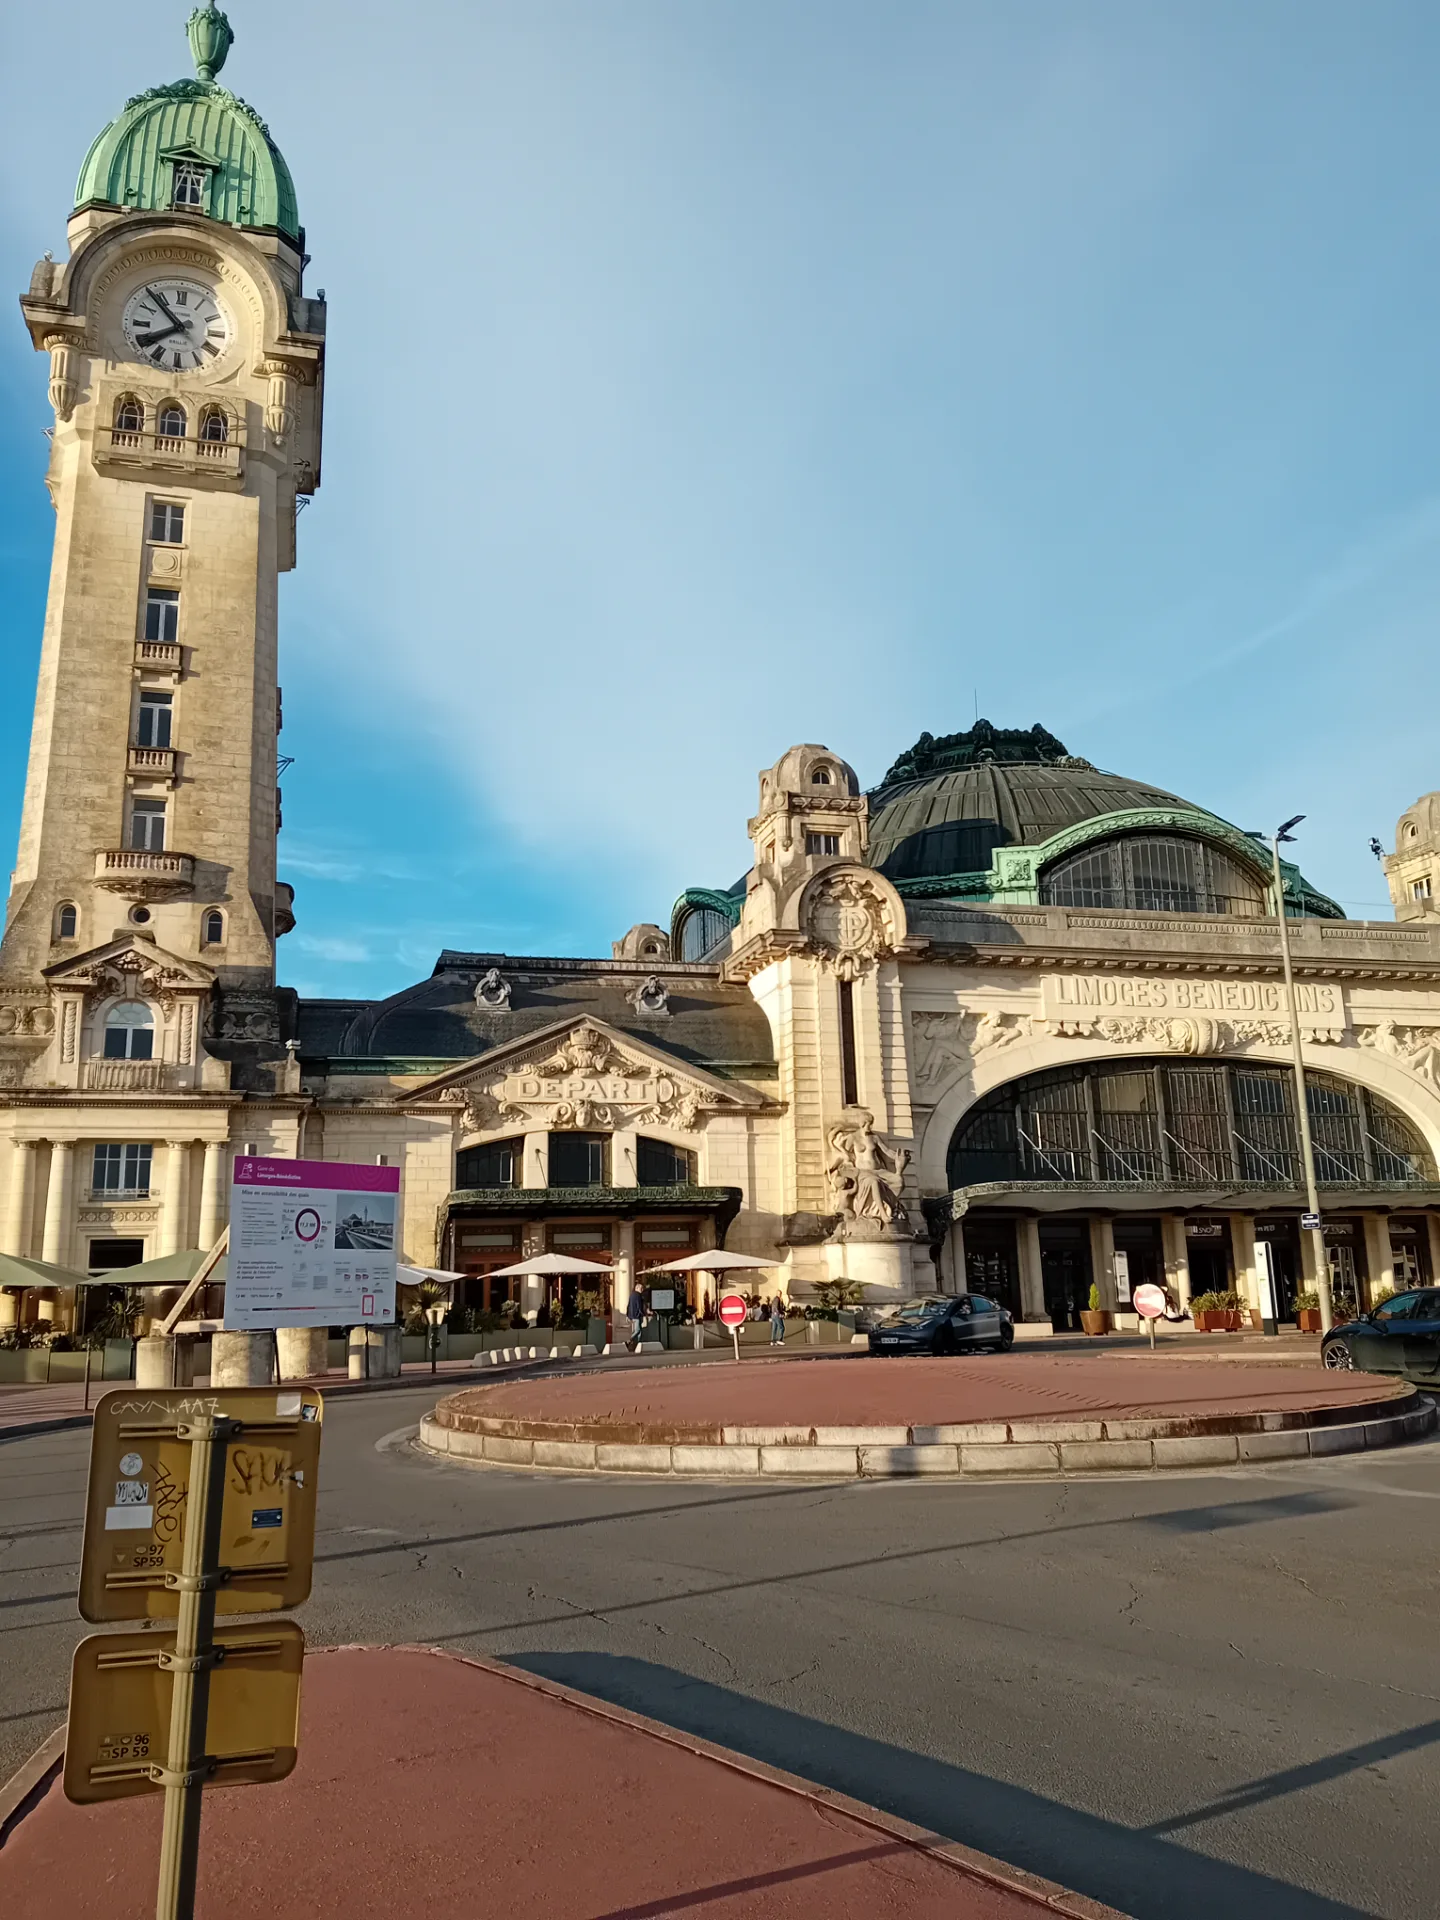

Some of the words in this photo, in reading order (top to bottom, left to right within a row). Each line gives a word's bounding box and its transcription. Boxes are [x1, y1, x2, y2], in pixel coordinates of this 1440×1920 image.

[1056, 977, 1167, 1008] LIMOGES
[517, 1078, 654, 1099] DEPART
[149, 1544, 164, 1556] 97
[133, 1556, 148, 1568] SP
[149, 1556, 164, 1567] 59
[134, 1734, 150, 1746] 96
[111, 1746, 129, 1759] SP
[132, 1745, 149, 1758] 59
